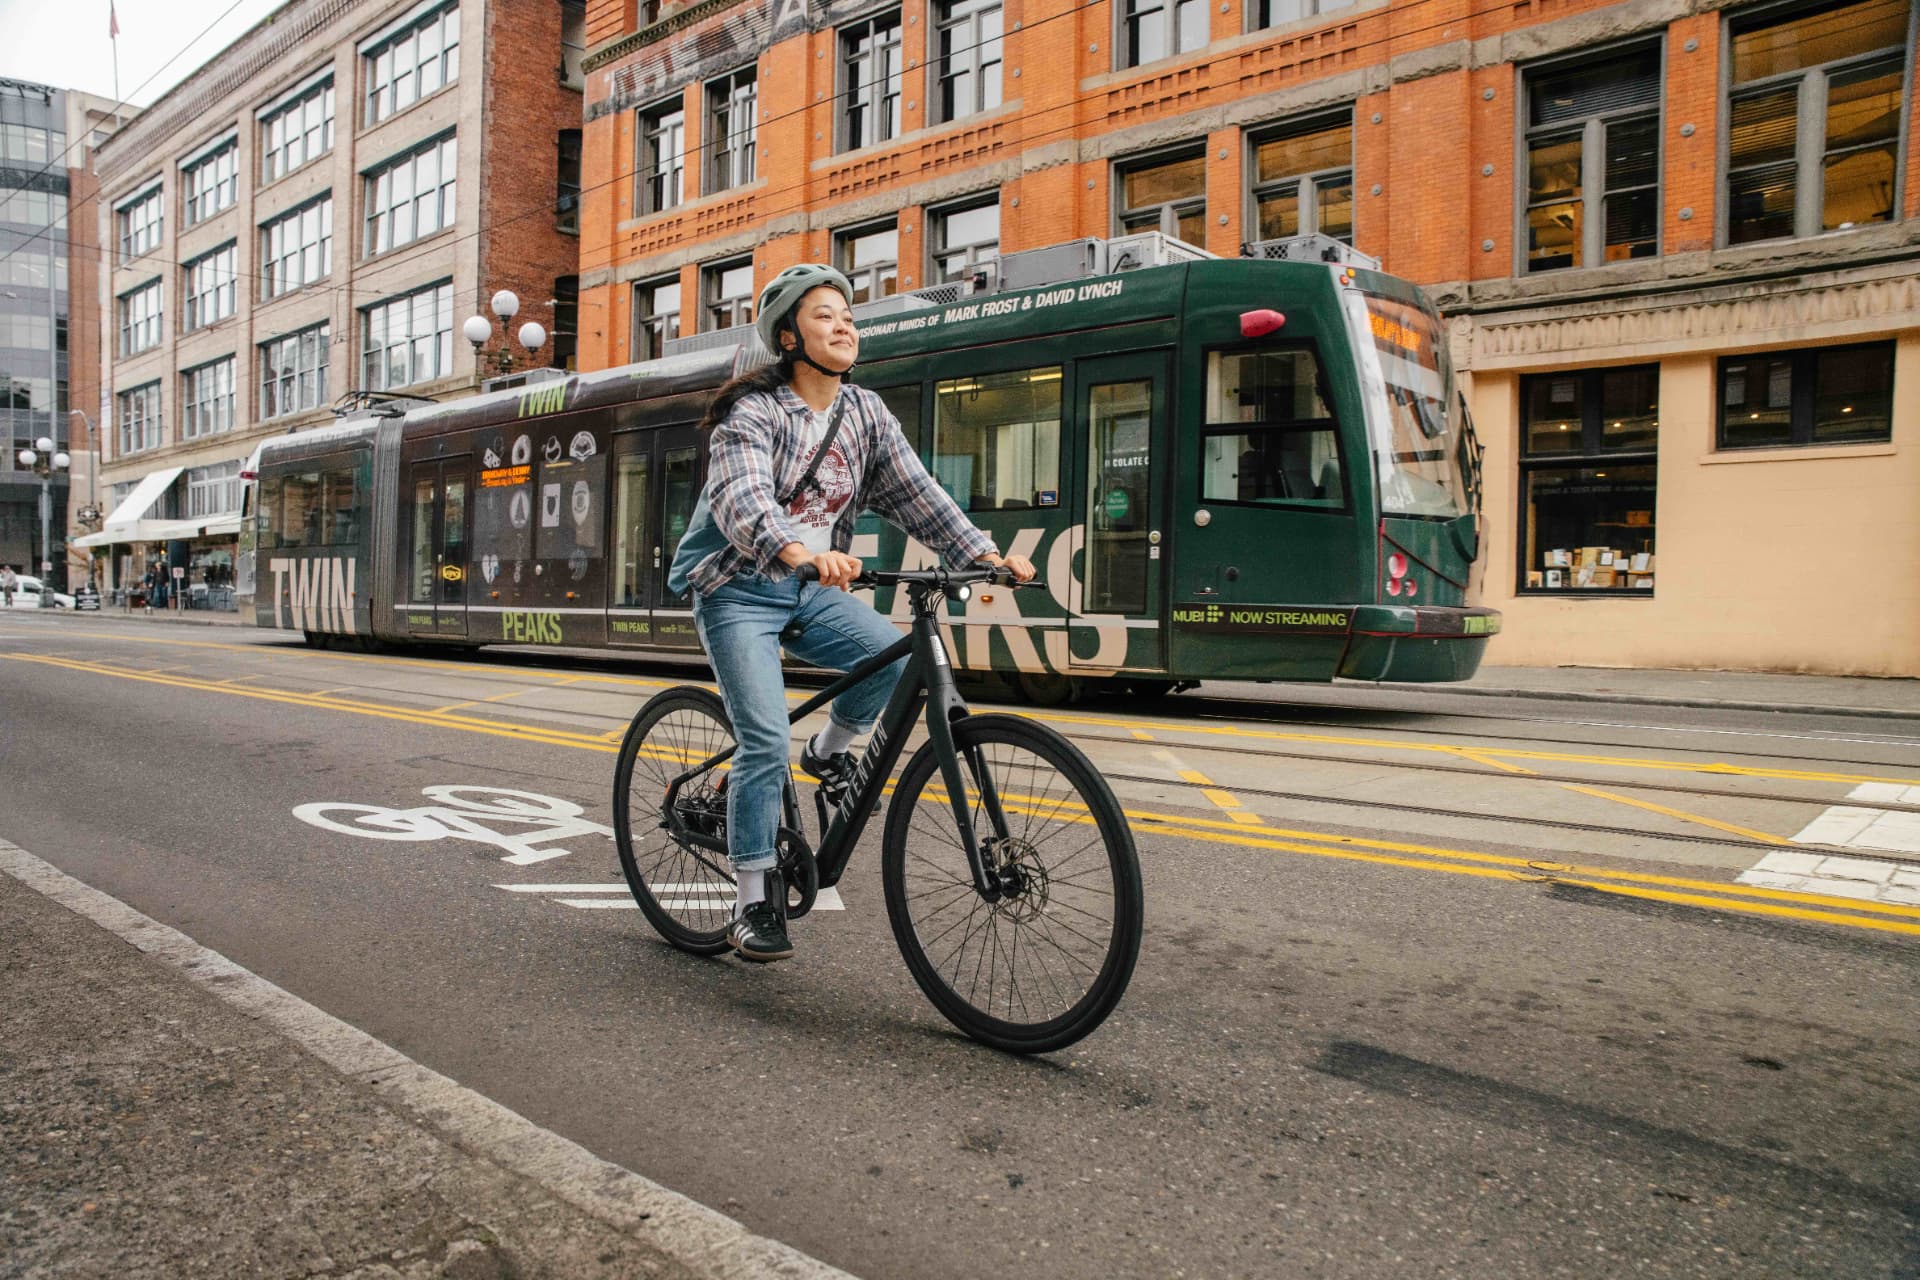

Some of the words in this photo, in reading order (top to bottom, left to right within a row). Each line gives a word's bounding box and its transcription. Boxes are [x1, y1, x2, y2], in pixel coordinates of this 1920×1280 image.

[898, 316, 926, 331] MINDS
[927, 314, 940, 326] OF
[944, 304, 980, 324] MARK
[981, 298, 1020, 317] FROST
[1021, 296, 1032, 311] &
[1035, 288, 1076, 308] DAVID
[1078, 280, 1123, 301] LYNCH
[518, 379, 567, 418] TWIN
[269, 557, 357, 635] TWIN
[502, 610, 563, 644] PEAKS
[612, 621, 628, 632] TWIN
[628, 622, 650, 634] PEAKS
[1173, 610, 1204, 623] MUBI
[1230, 611, 1264, 624] NOW
[1265, 611, 1347, 626] STREAMING
